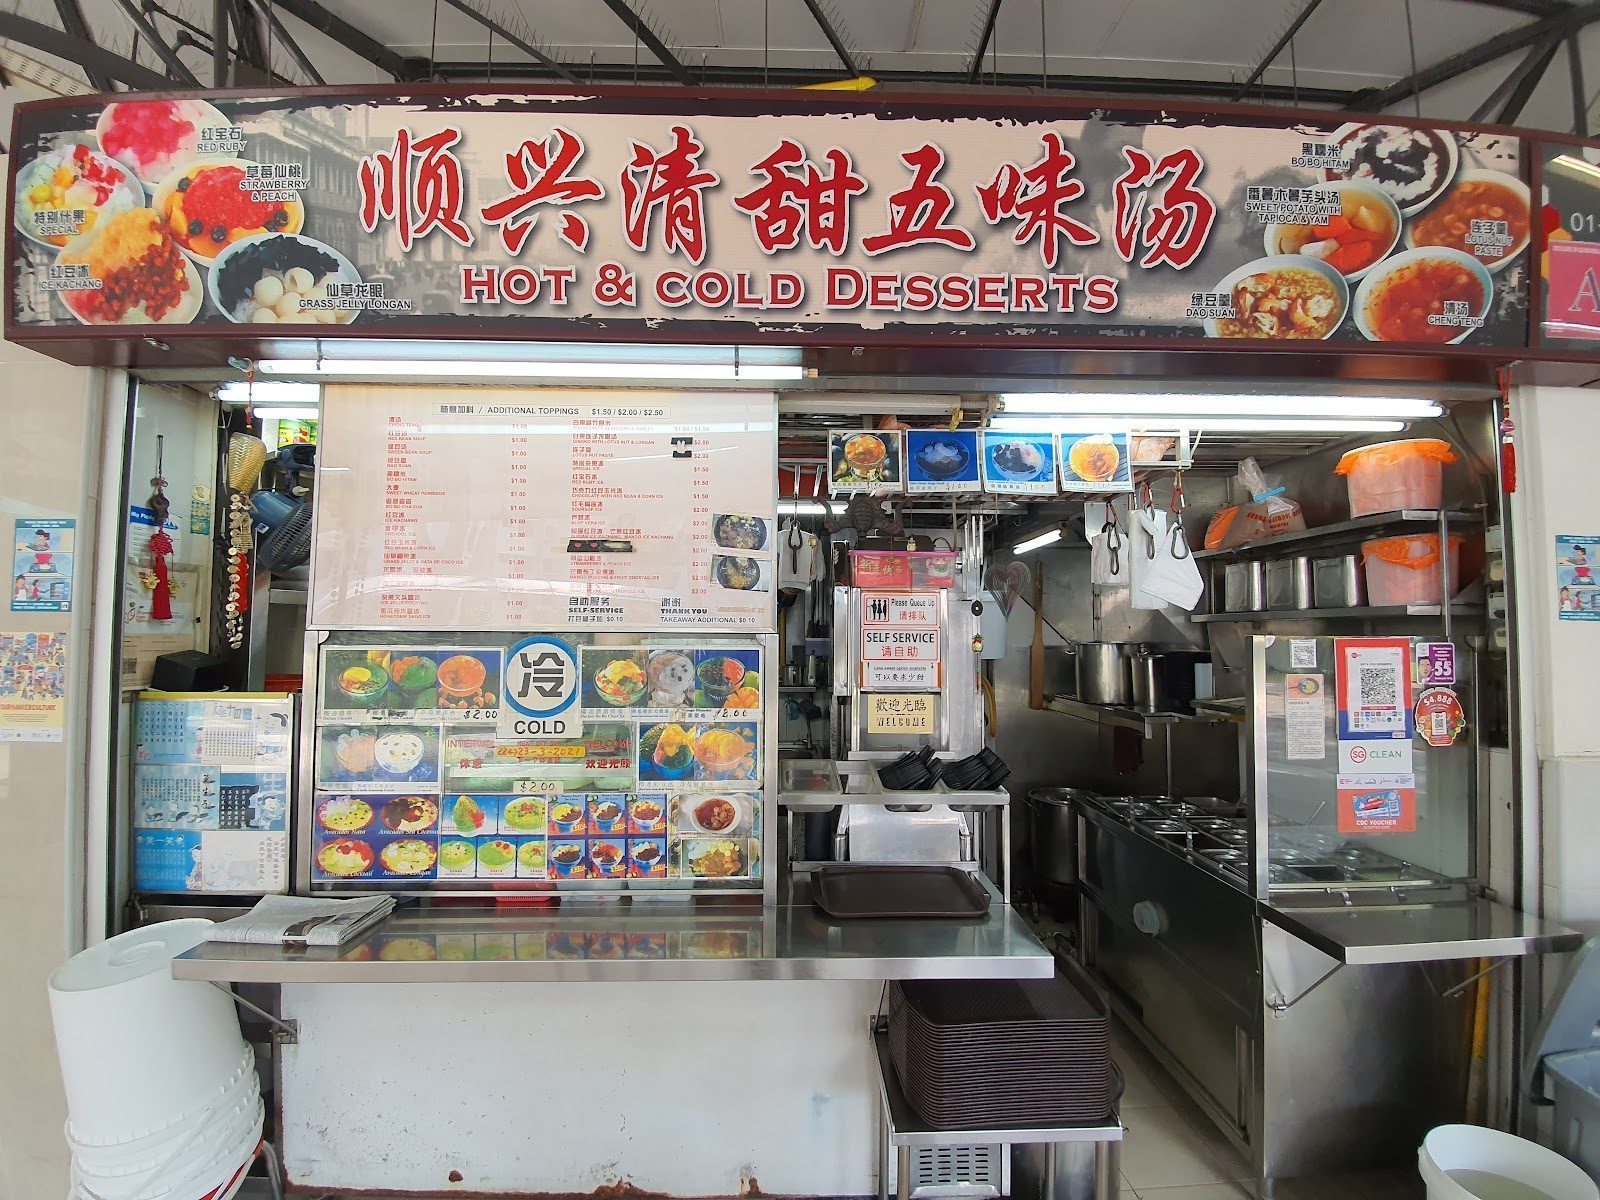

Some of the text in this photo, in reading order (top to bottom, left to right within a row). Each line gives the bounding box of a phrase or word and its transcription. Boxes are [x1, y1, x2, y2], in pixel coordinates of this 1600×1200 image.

[201, 127, 242, 141] 红宝石
[197, 141, 246, 153] RED RUBY
[1291, 157, 1349, 169] BO BO HITAM
[246, 165, 301, 180] 草莓仙桃
[240, 179, 308, 191] STRAWBERRY
[252, 191, 296, 202] & PEACH
[358, 123, 1216, 269] 顺兴清甜五味汤
[1245, 203, 1341, 215] SWEET POTATO WITH
[1259, 213, 1328, 225] TAPIOCA & YAM
[40, 225, 79, 236] SPECIAL
[1466, 235, 1513, 245] LOTUS NUT
[1476, 246, 1502, 256] PASTE
[50, 265, 90, 279] 红豆冰
[39, 279, 102, 290] ICE KACHANG
[460, 262, 1119, 314] HOT & COLD DESSERTS
[326, 283, 384, 298] 仙草龙眼
[299, 299, 411, 310] GRASS JELLY LONGAN
[1186, 308, 1235, 318] DAO SUAN
[1428, 315, 1484, 326] CHENG TENG
[488, 406, 536, 415] ADDITIONAL
[539, 407, 579, 415] TOPPINGS
[591, 408, 612, 416] $1.50
[617, 408, 638, 417] $2.00
[643, 409, 664, 417] $2.50
[569, 597, 610, 606] 自助服务
[661, 597, 681, 607] 谢谢
[891, 598, 935, 608] Please Queue Up
[899, 611, 926, 621] 请排队
[867, 632, 935, 643] SELF SERVICE
[881, 646, 918, 657] 请自助
[1434, 660, 1452, 676] 55
[518, 652, 565, 698] 冷
[876, 698, 927, 713] 歡迎光臨
[463, 709, 498, 721] $2.00
[514, 720, 566, 735] COLD
[877, 717, 926, 727] WELCOME
[1352, 751, 1402, 759] SG CLEAN
[520, 782, 556, 793] $2.00
